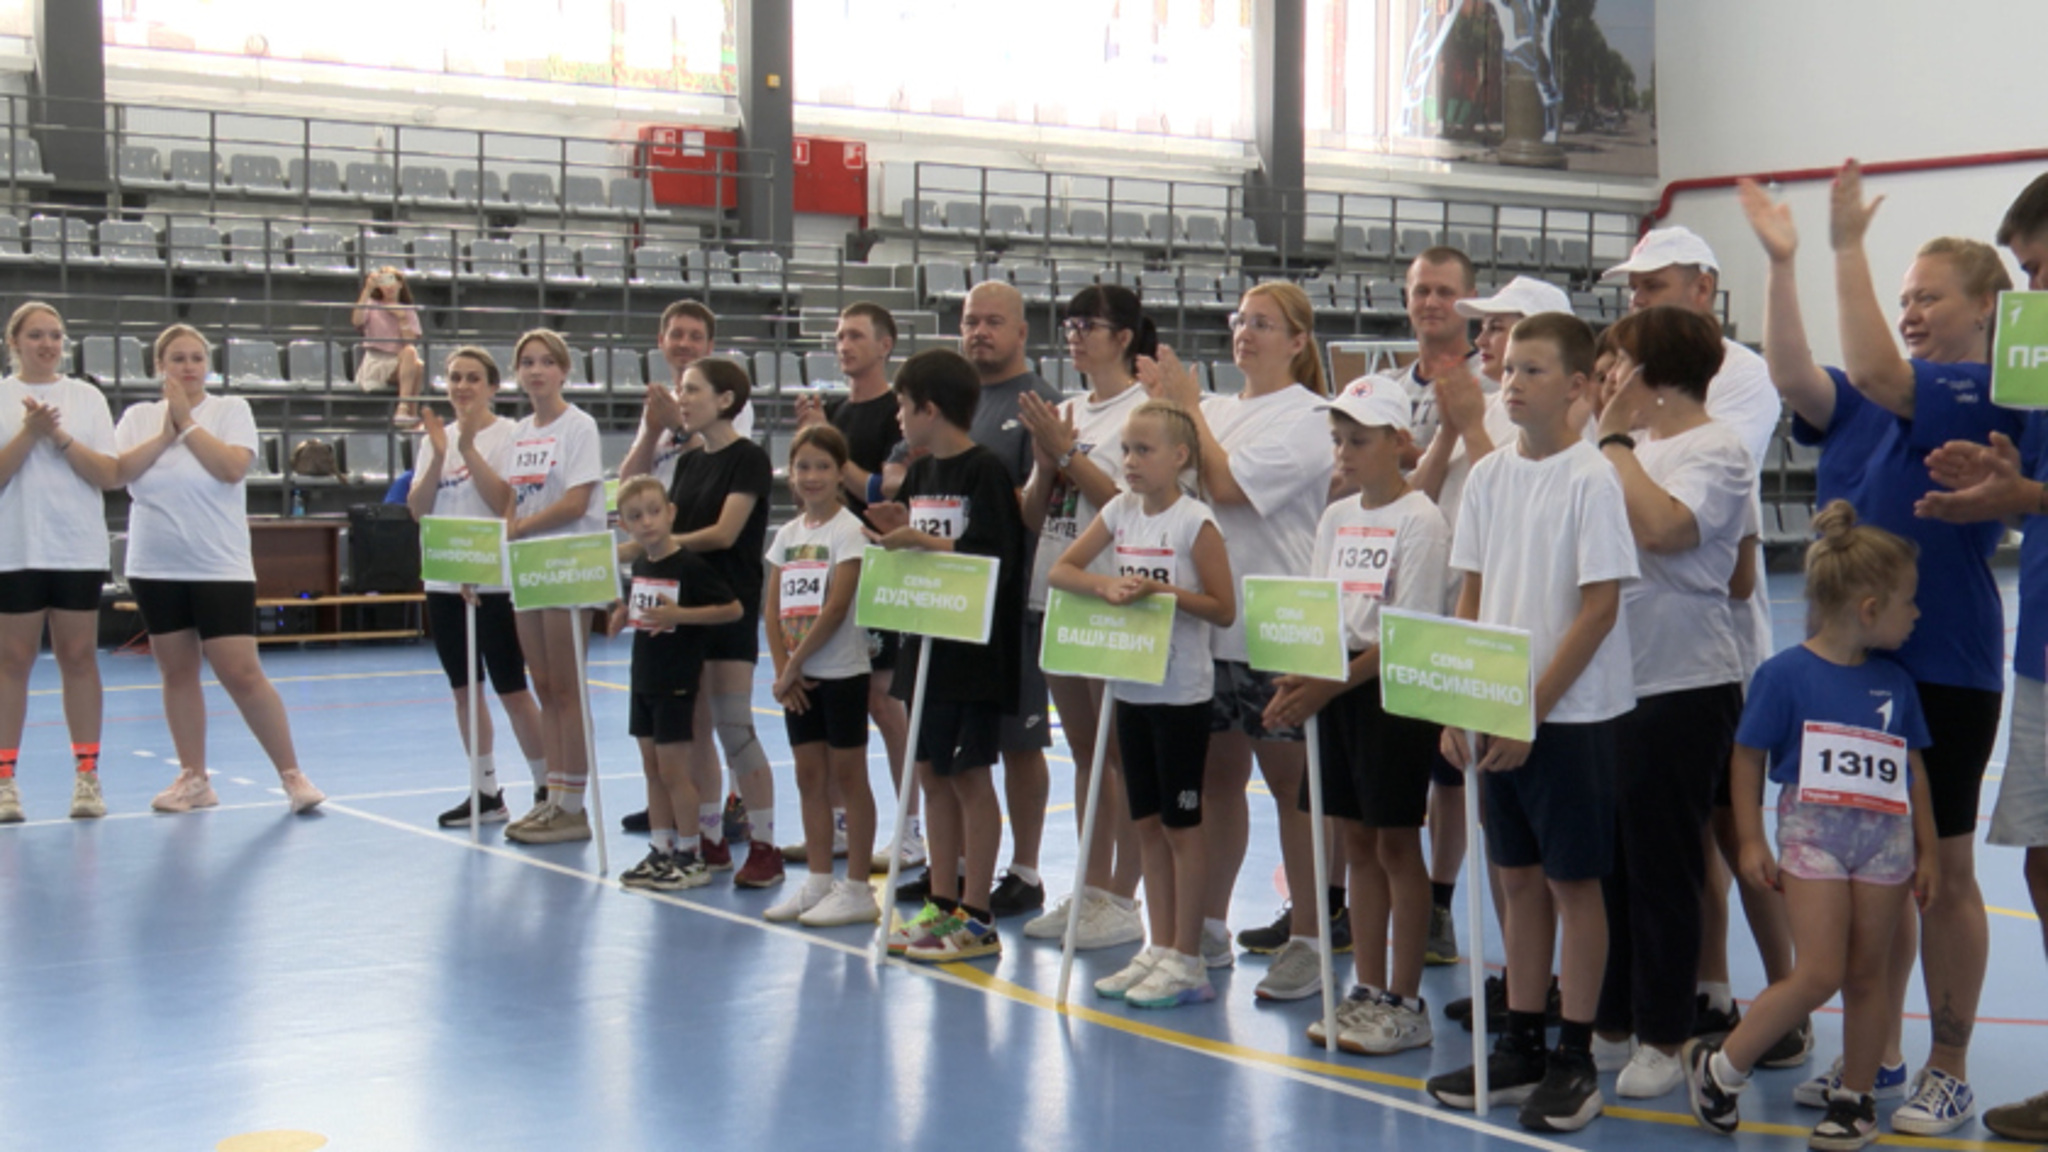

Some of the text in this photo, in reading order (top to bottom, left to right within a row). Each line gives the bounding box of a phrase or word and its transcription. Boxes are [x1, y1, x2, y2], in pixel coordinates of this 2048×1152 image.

[515, 451, 549, 468] 1317
[544, 557, 578, 569] СЕМЬЯ
[1337, 547, 1388, 569] 1320
[783, 577, 820, 597] 1324
[903, 574, 942, 589] СЕМЬЯ
[873, 586, 968, 613] ДУДЧЕНКО
[1090, 613, 1127, 627] СЕМЬЯ
[1057, 625, 1155, 654] ВАШКЕВИЧ
[1430, 651, 1475, 672] СЕМЬЯ
[1386, 662, 1524, 707] ГЕРАСИМЕНКО
[1818, 748, 1898, 785] 1319
